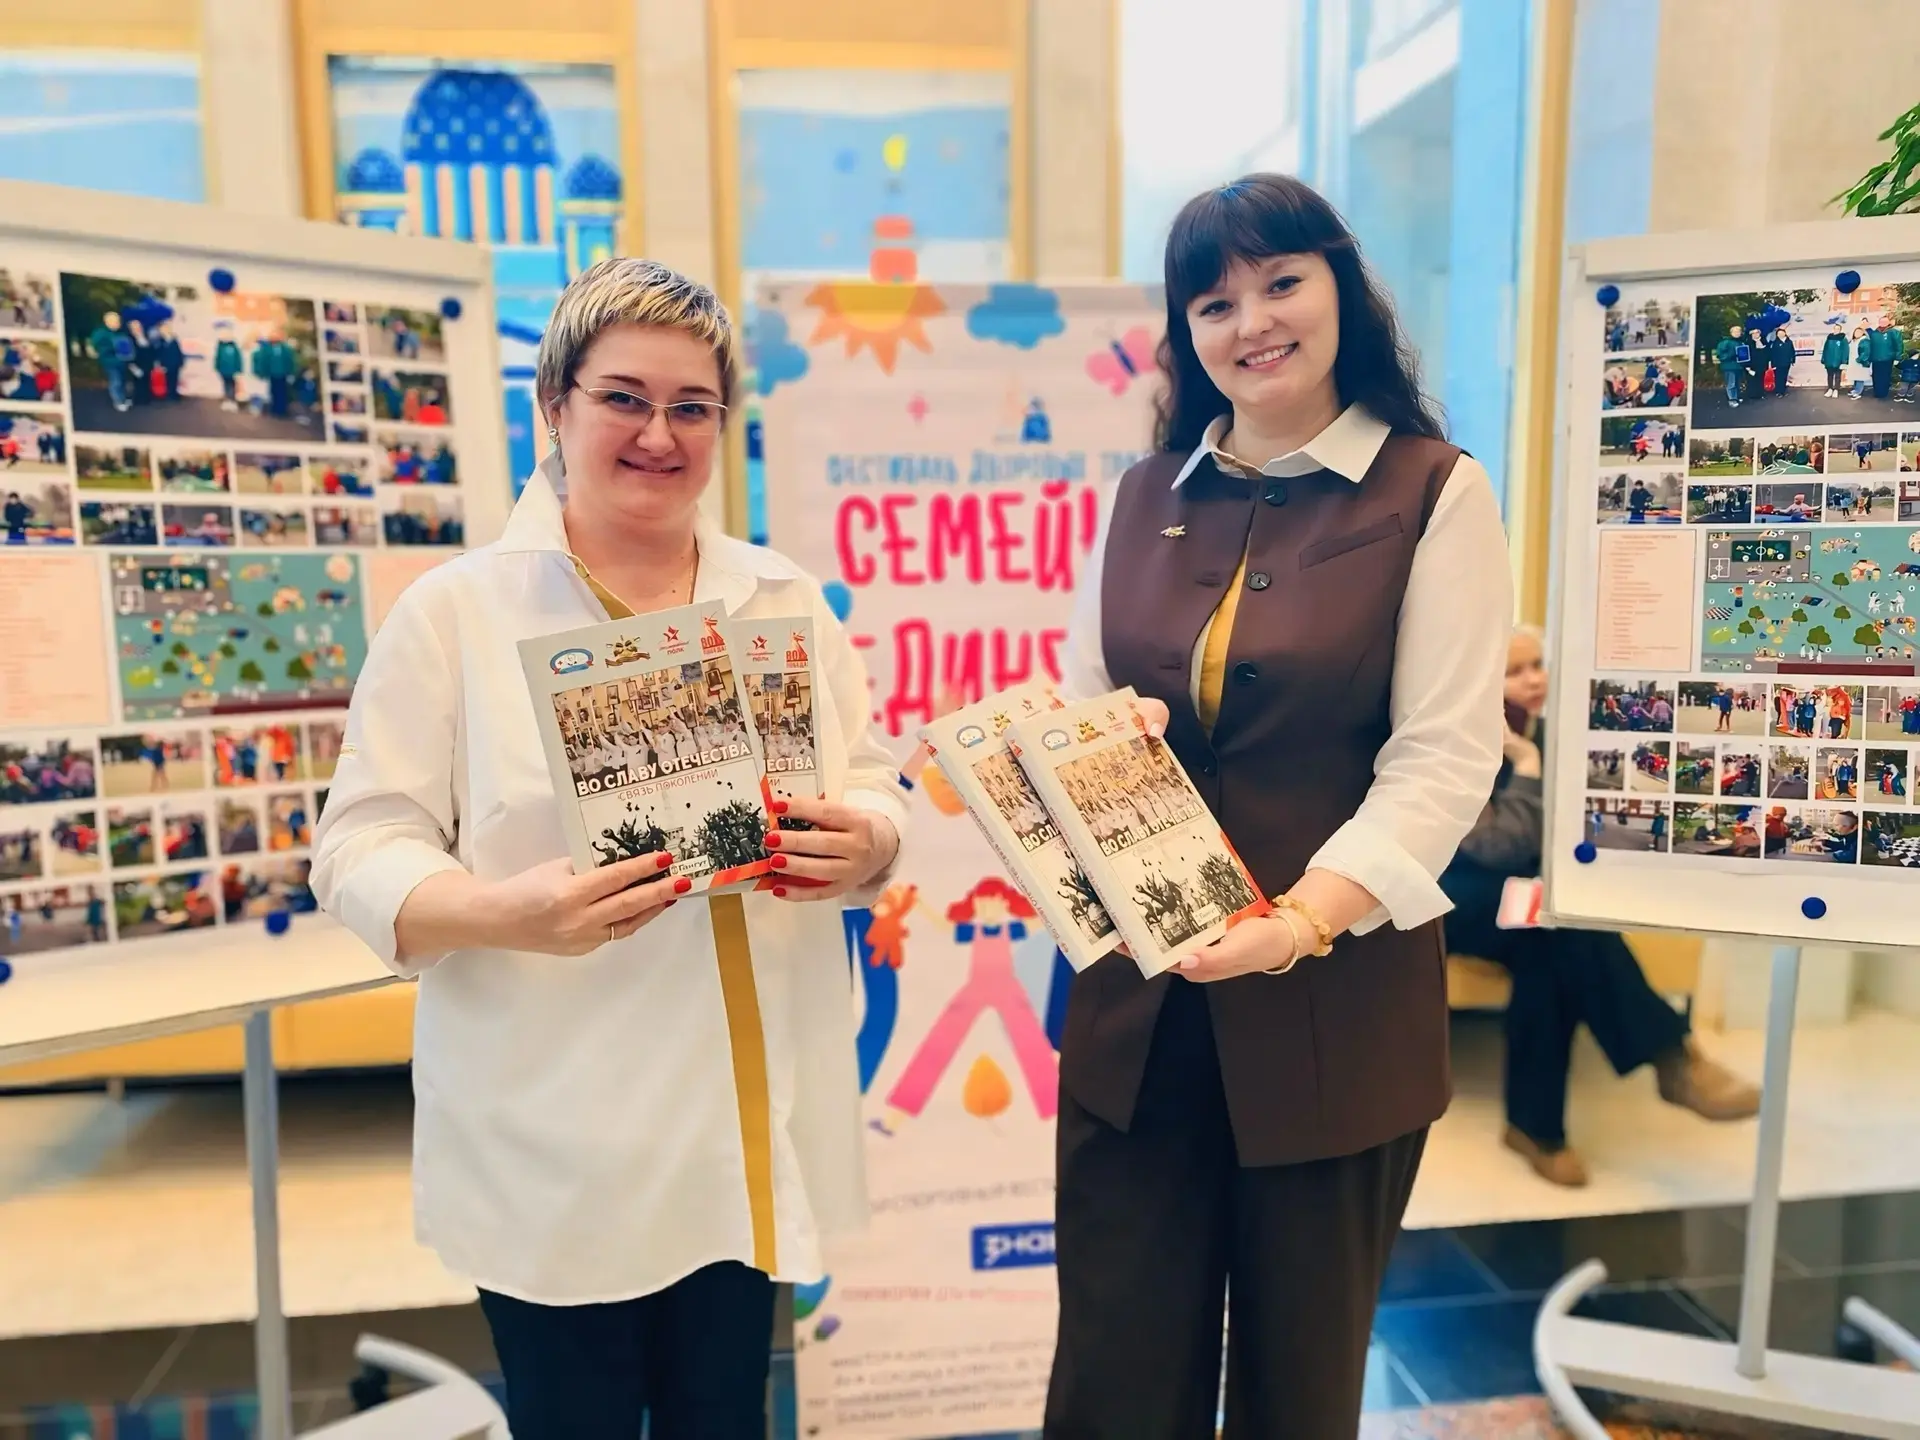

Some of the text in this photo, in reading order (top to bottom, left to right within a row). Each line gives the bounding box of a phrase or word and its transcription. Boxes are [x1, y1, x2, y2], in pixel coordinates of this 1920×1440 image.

[576, 741, 752, 797] ВО СЛАВУ ОТЕЧЕСТВА
[618, 786, 654, 802] СВЯЗЬ
[1021, 832, 1041, 852] ВО
[1100, 838, 1120, 856] ВО
[1116, 822, 1151, 848] СЛАВУ
[1150, 801, 1205, 833] ОТЕЧЕСТВА
